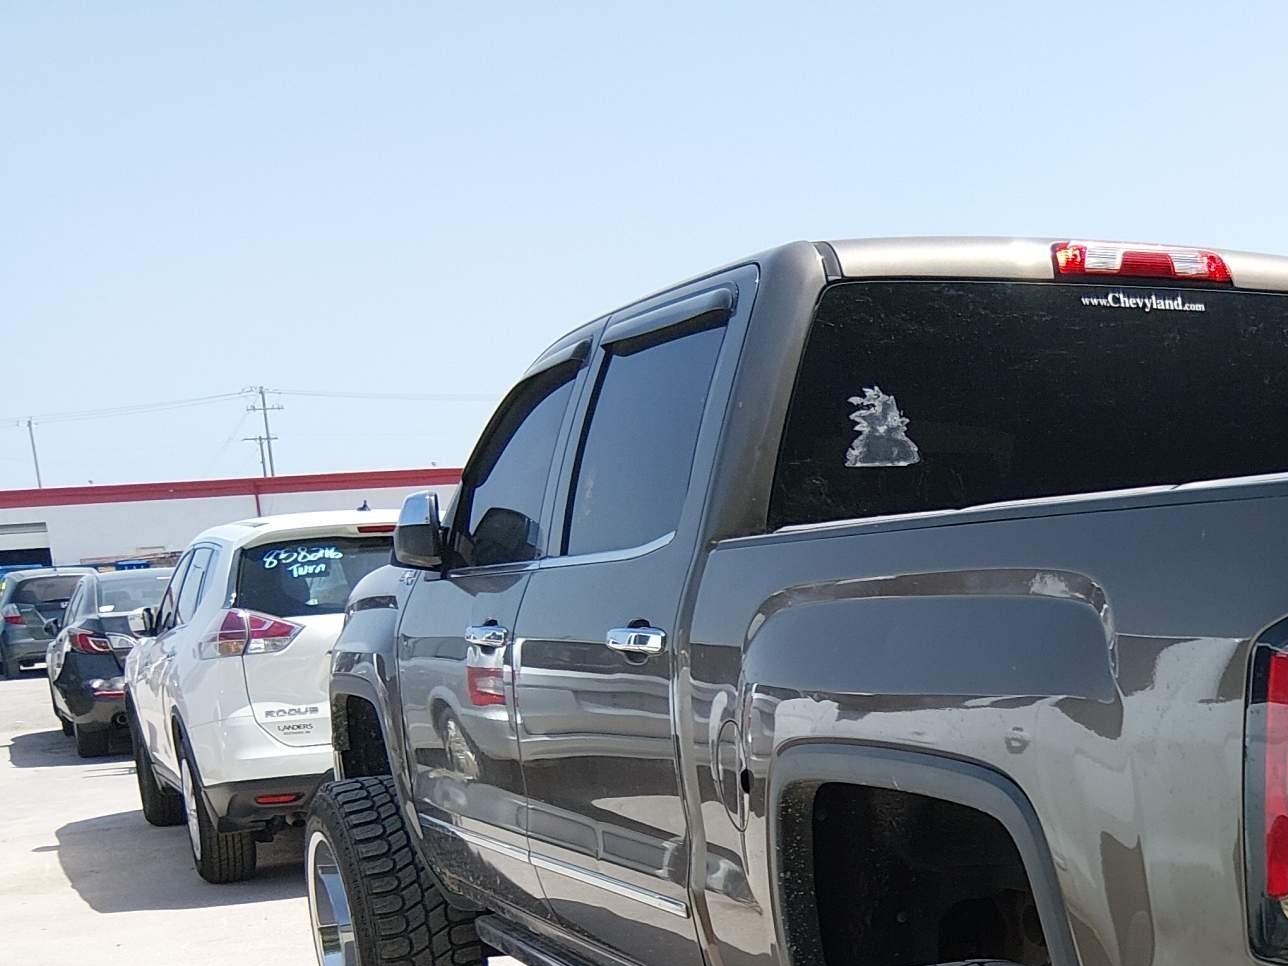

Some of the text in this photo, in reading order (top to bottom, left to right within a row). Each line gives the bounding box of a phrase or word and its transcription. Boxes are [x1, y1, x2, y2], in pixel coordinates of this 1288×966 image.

[1080, 292, 1206, 312] www.Chevyland.com
[287, 563, 327, 578] Turn
[264, 706, 319, 718] ROGUE
